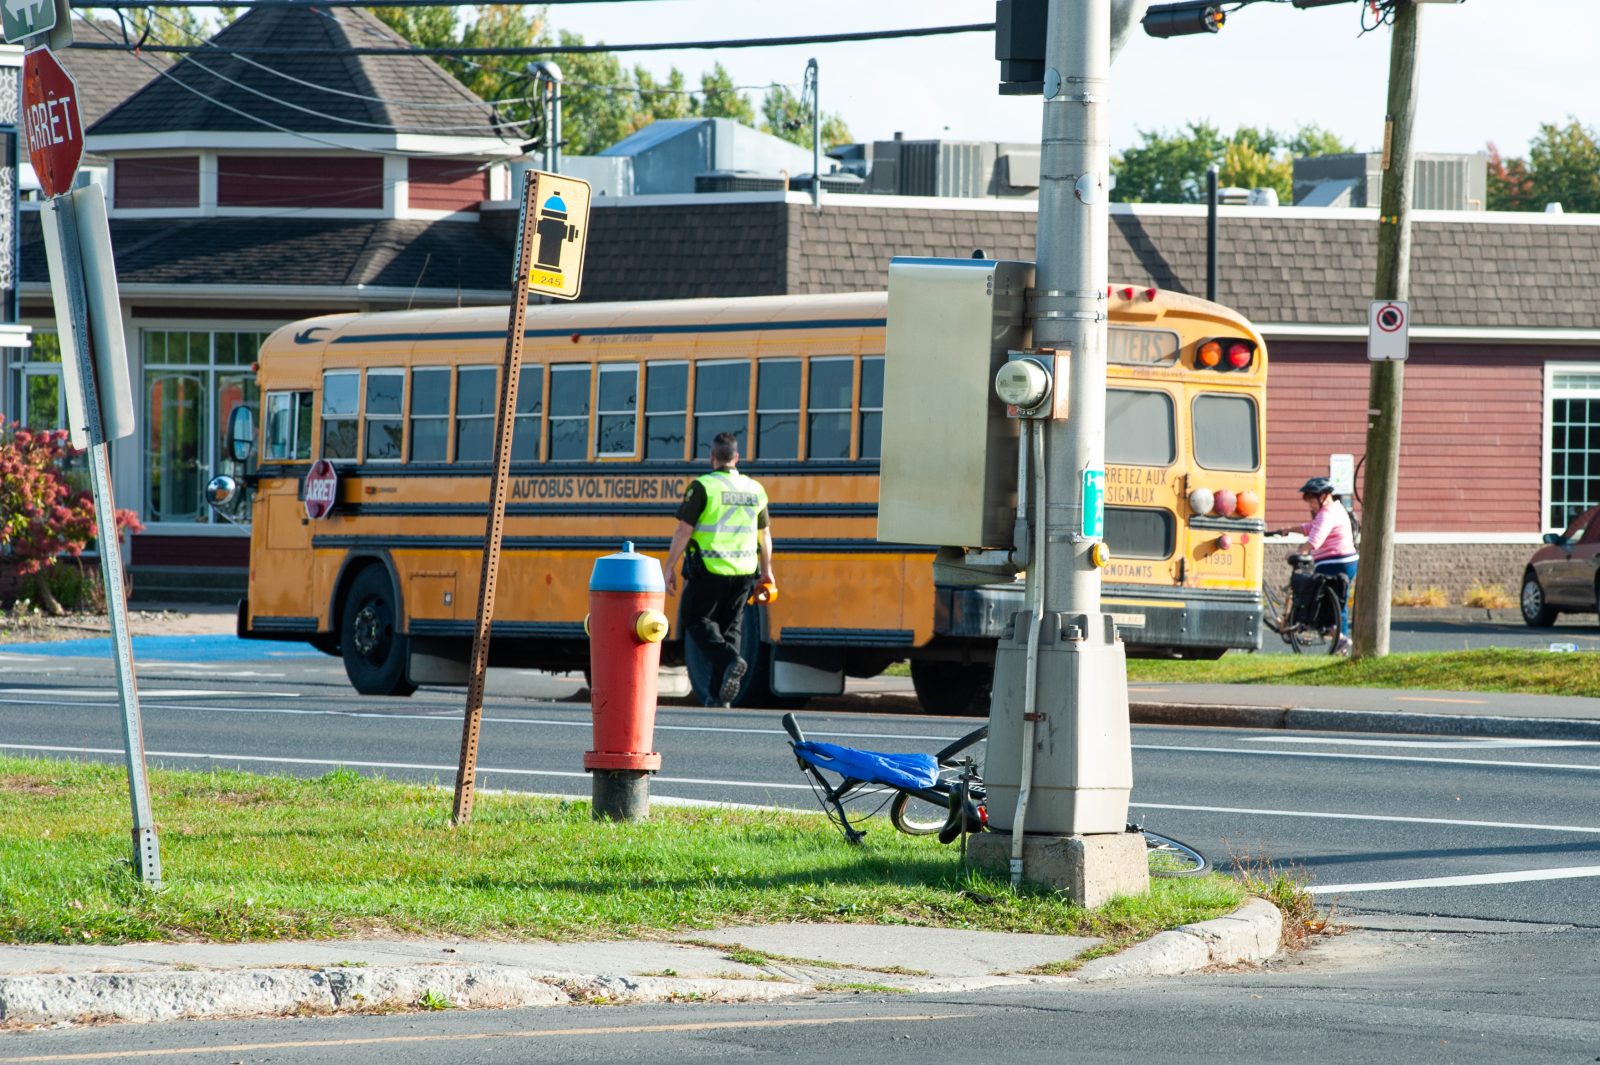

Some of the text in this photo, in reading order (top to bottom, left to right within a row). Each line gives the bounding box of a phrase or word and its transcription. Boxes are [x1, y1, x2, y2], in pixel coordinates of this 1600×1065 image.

[26, 90, 73, 154] ARRÊT
[540, 275, 561, 287] 245
[1146, 469, 1168, 485] AUX
[512, 479, 574, 498] AUTOBUS
[577, 478, 658, 498] VOLTIGEURS
[1107, 486, 1155, 503] SIGNAUX
[723, 492, 758, 506] POLICE
